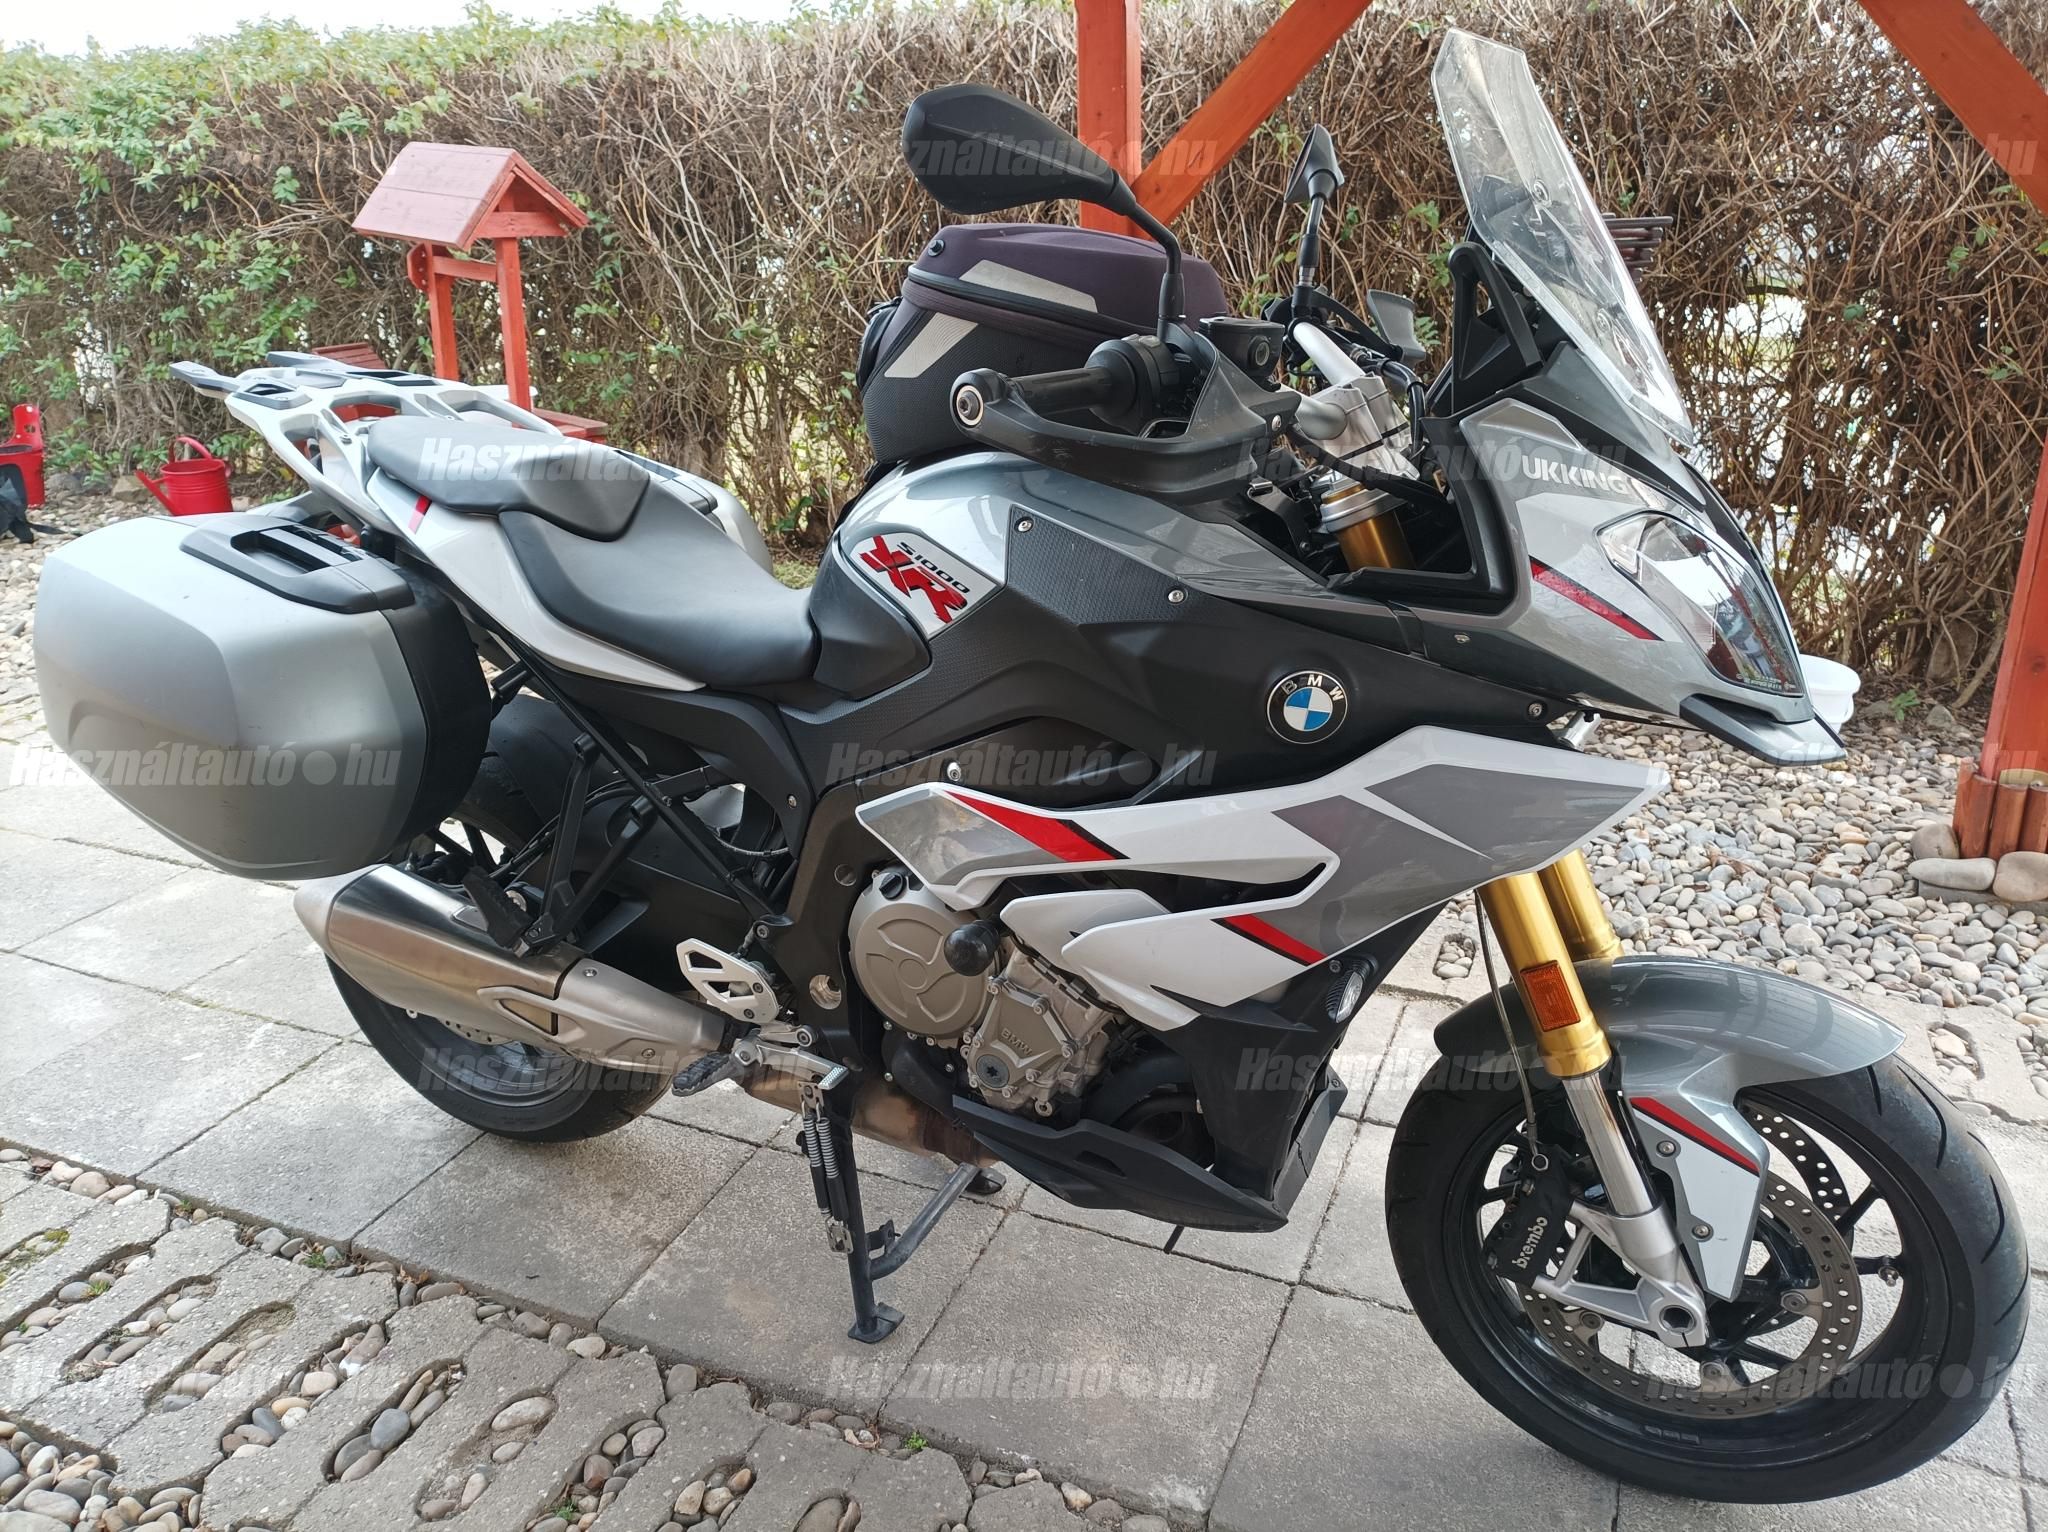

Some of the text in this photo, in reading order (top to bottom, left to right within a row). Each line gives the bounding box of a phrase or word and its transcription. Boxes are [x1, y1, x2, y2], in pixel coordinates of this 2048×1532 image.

[1522, 455, 1630, 494] UKKING
[859, 535, 968, 624] XR
[897, 542, 971, 594] S1000
[1281, 674, 1345, 702] BMW
[1001, 1027, 1033, 1056] BMW
[1511, 1216, 1548, 1269] brembo
